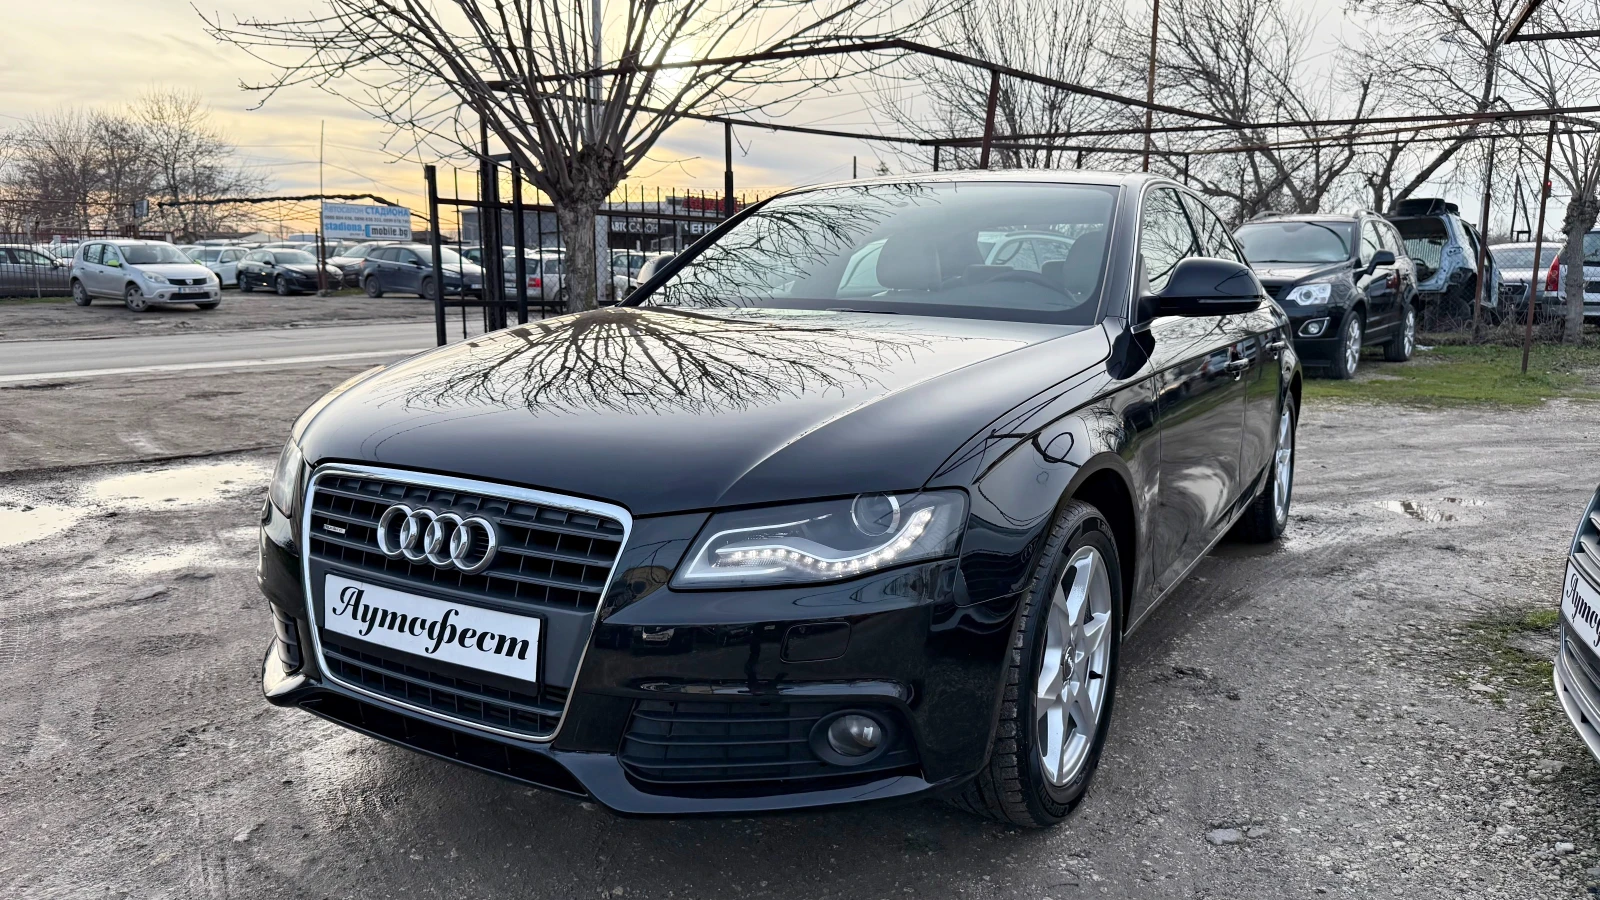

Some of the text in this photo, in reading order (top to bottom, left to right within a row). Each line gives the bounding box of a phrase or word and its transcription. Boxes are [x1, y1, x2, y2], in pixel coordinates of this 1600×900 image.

[365, 206, 409, 217] СТАДИОНА
[371, 226, 409, 238] mobile.bg
[332, 586, 530, 660] Аутофест
